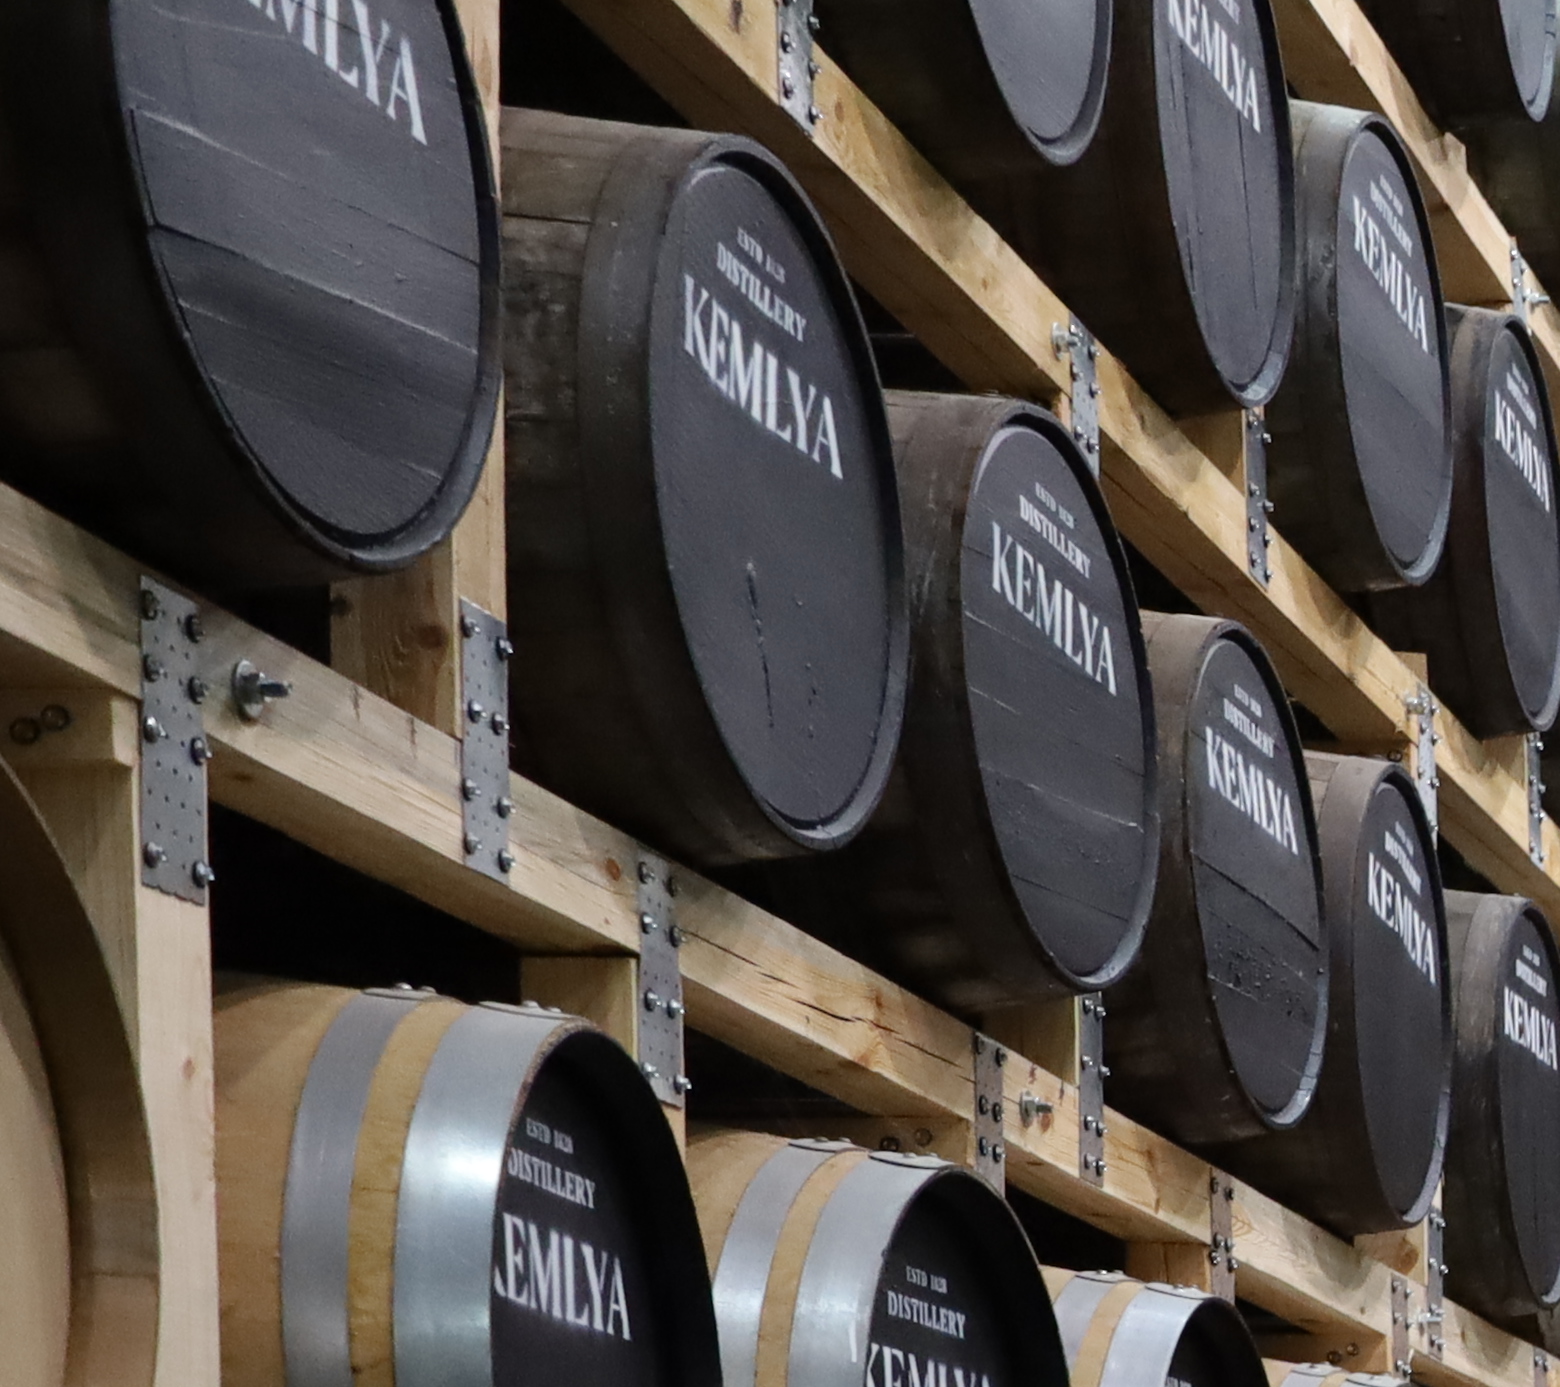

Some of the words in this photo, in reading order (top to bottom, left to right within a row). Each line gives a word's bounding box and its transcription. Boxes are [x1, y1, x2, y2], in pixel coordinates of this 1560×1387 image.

[717, 242, 807, 343] DISTILLERY
[1352, 194, 1429, 355] KEMLYA
[684, 273, 844, 480] KEMLYA
[1494, 389, 1551, 514] KEMLYA
[1018, 494, 1091, 579] DISTILLERY
[992, 520, 1118, 697] KEMLYA
[1205, 725, 1299, 856] KEMLYA
[1368, 851, 1437, 986] KEMLYA
[1503, 985, 1559, 1072] KEMLYA
[887, 1289, 966, 1339] DISTILLERY
